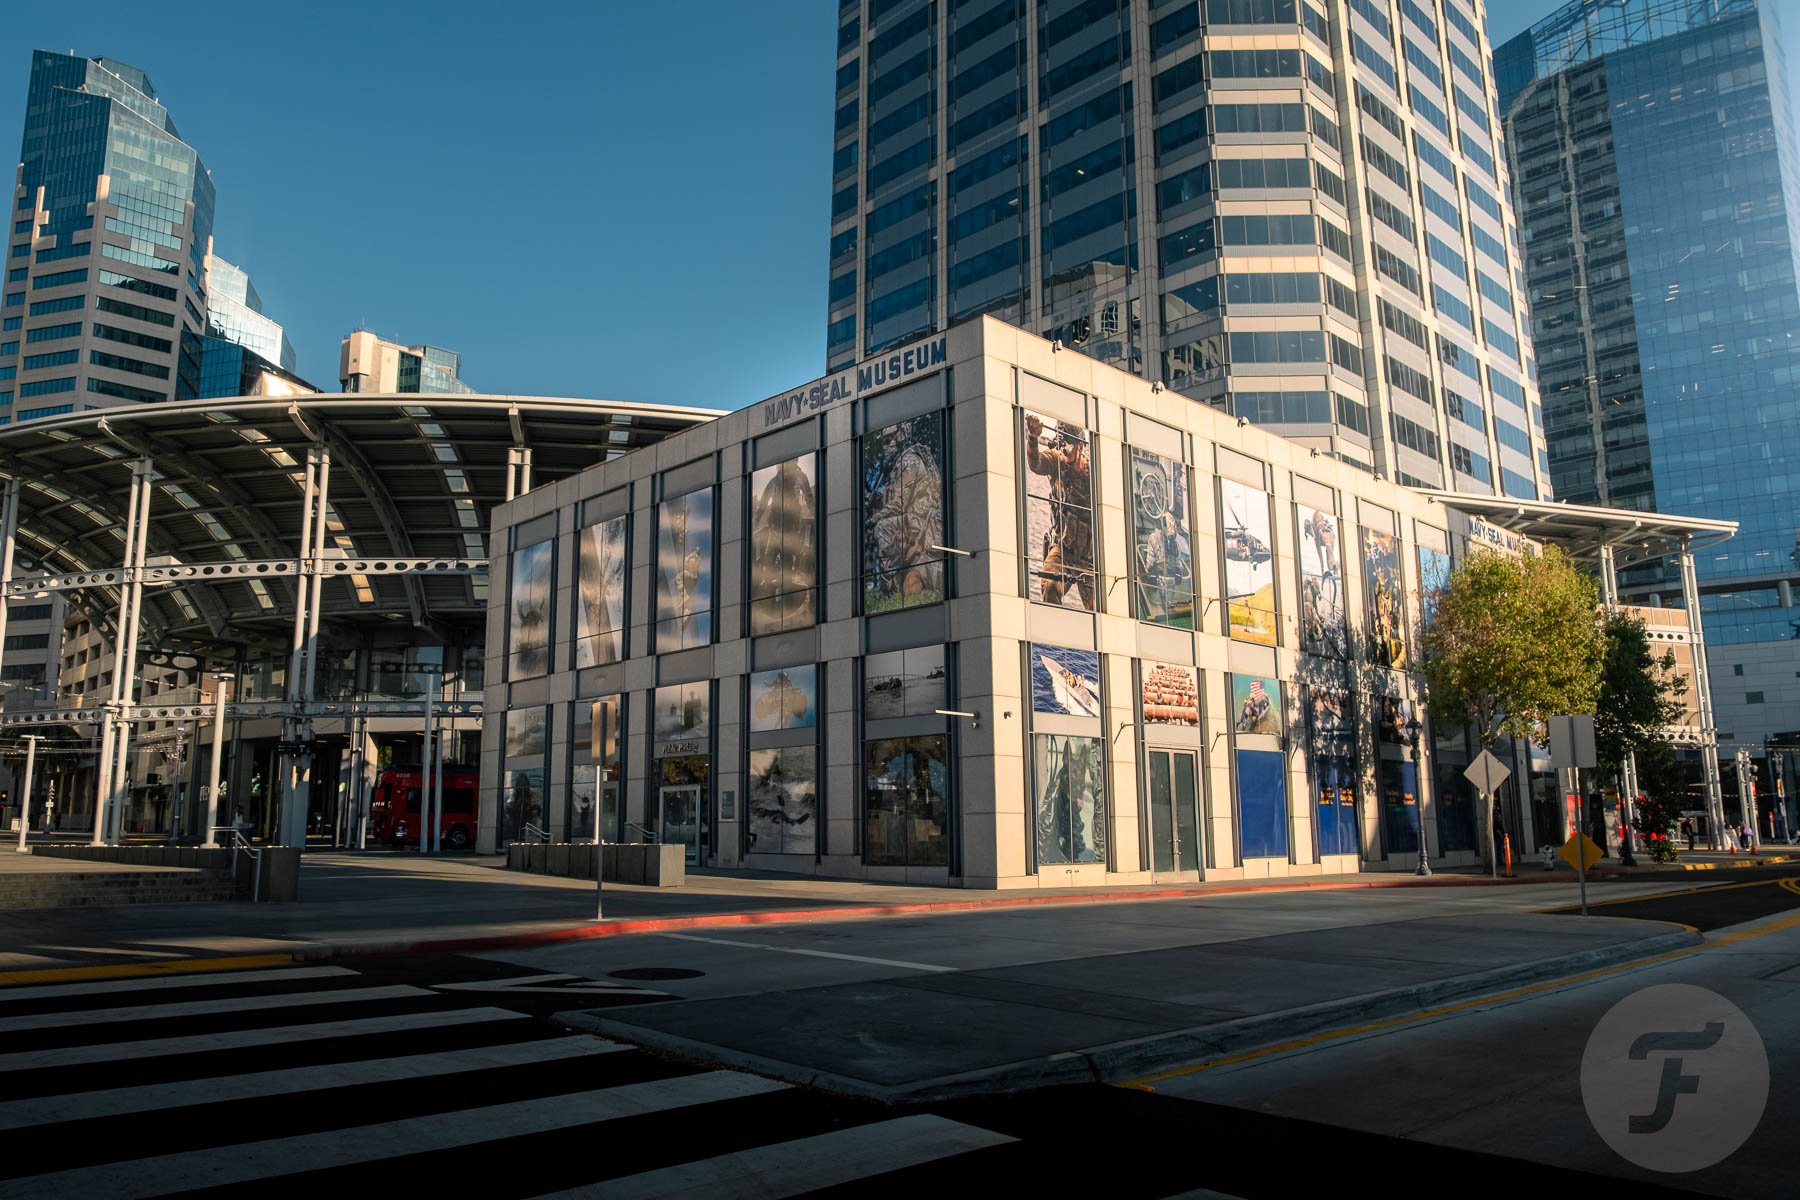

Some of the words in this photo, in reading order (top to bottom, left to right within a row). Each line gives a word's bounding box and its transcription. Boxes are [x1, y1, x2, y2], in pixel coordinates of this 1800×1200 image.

[765, 392, 805, 427] NAVY
[809, 376, 851, 410] SEAL
[858, 338, 946, 392] MUSEUM
[1488, 527, 1504, 548] SEAL
